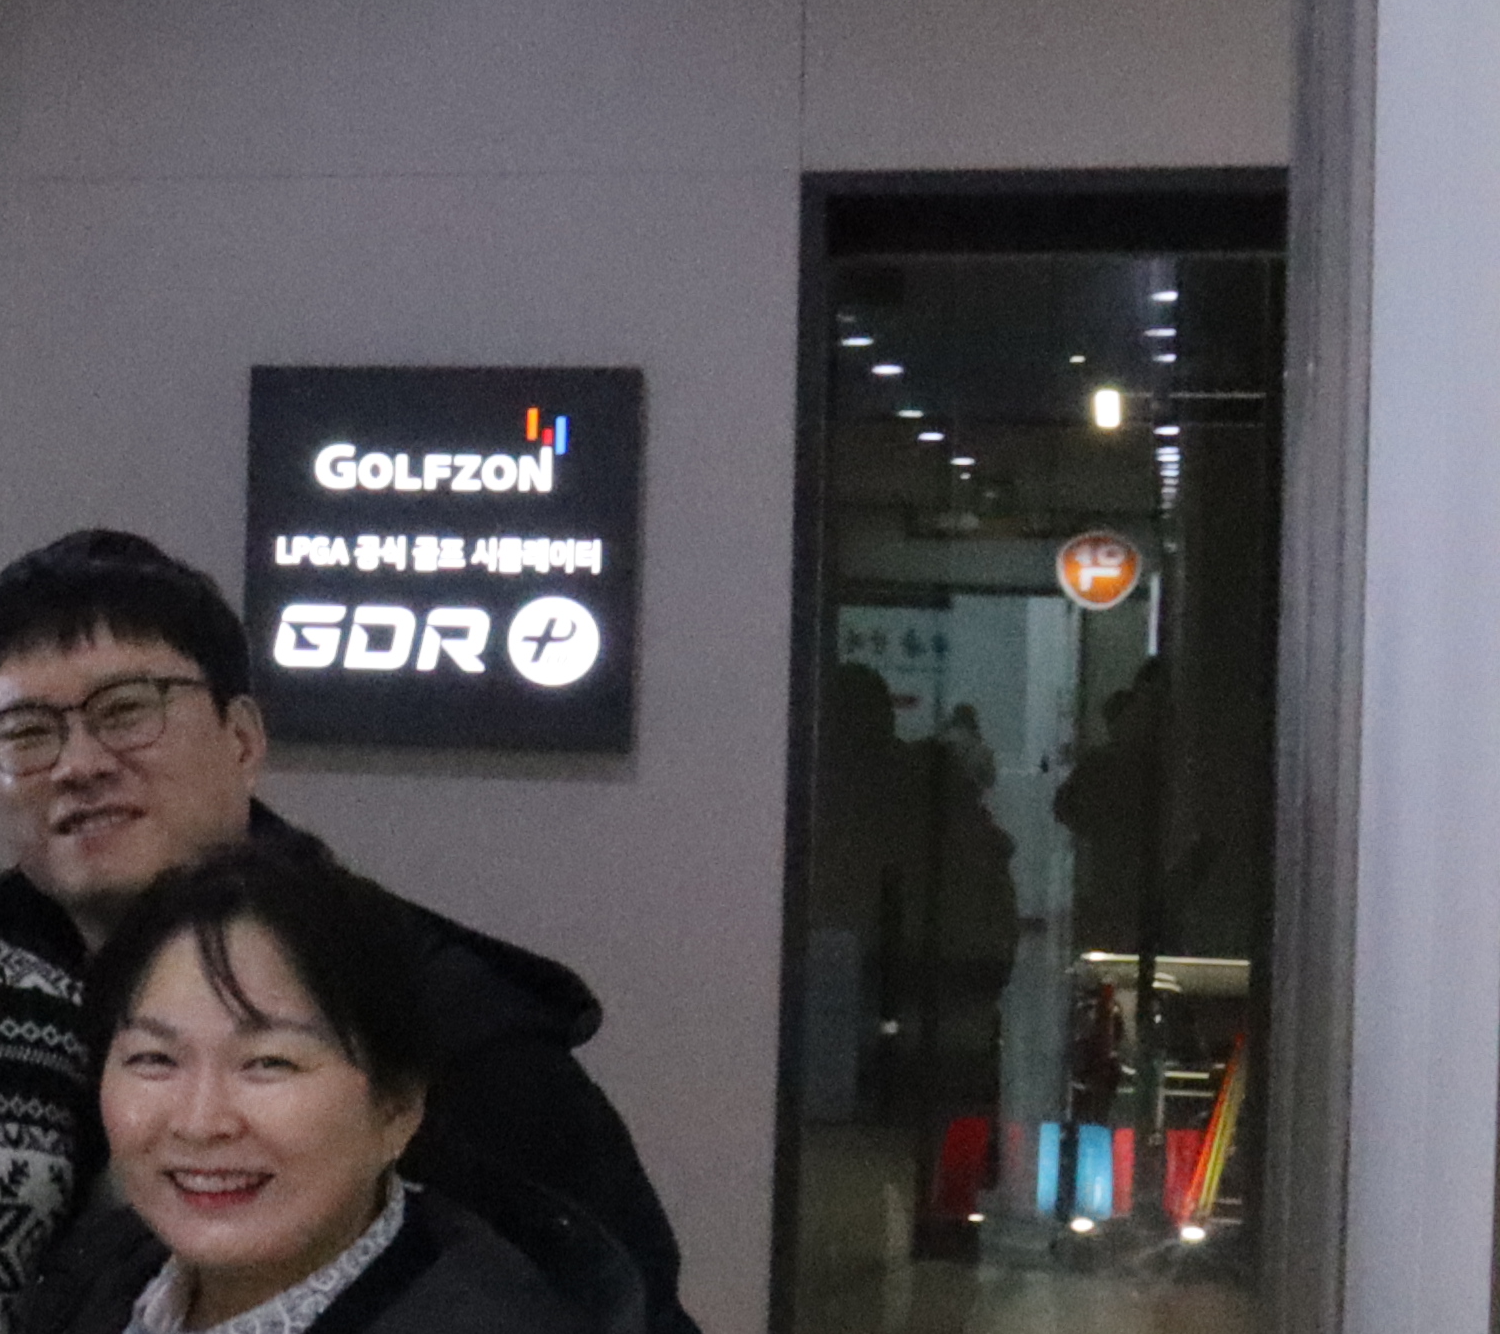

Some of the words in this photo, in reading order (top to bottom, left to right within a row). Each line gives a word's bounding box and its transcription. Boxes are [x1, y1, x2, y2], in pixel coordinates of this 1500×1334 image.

[314, 443, 554, 492] GOLFZON
[275, 535, 350, 566] LPGA
[354, 534, 407, 571] 공식
[411, 535, 467, 573] 골프
[273, 603, 491, 673] GDR
